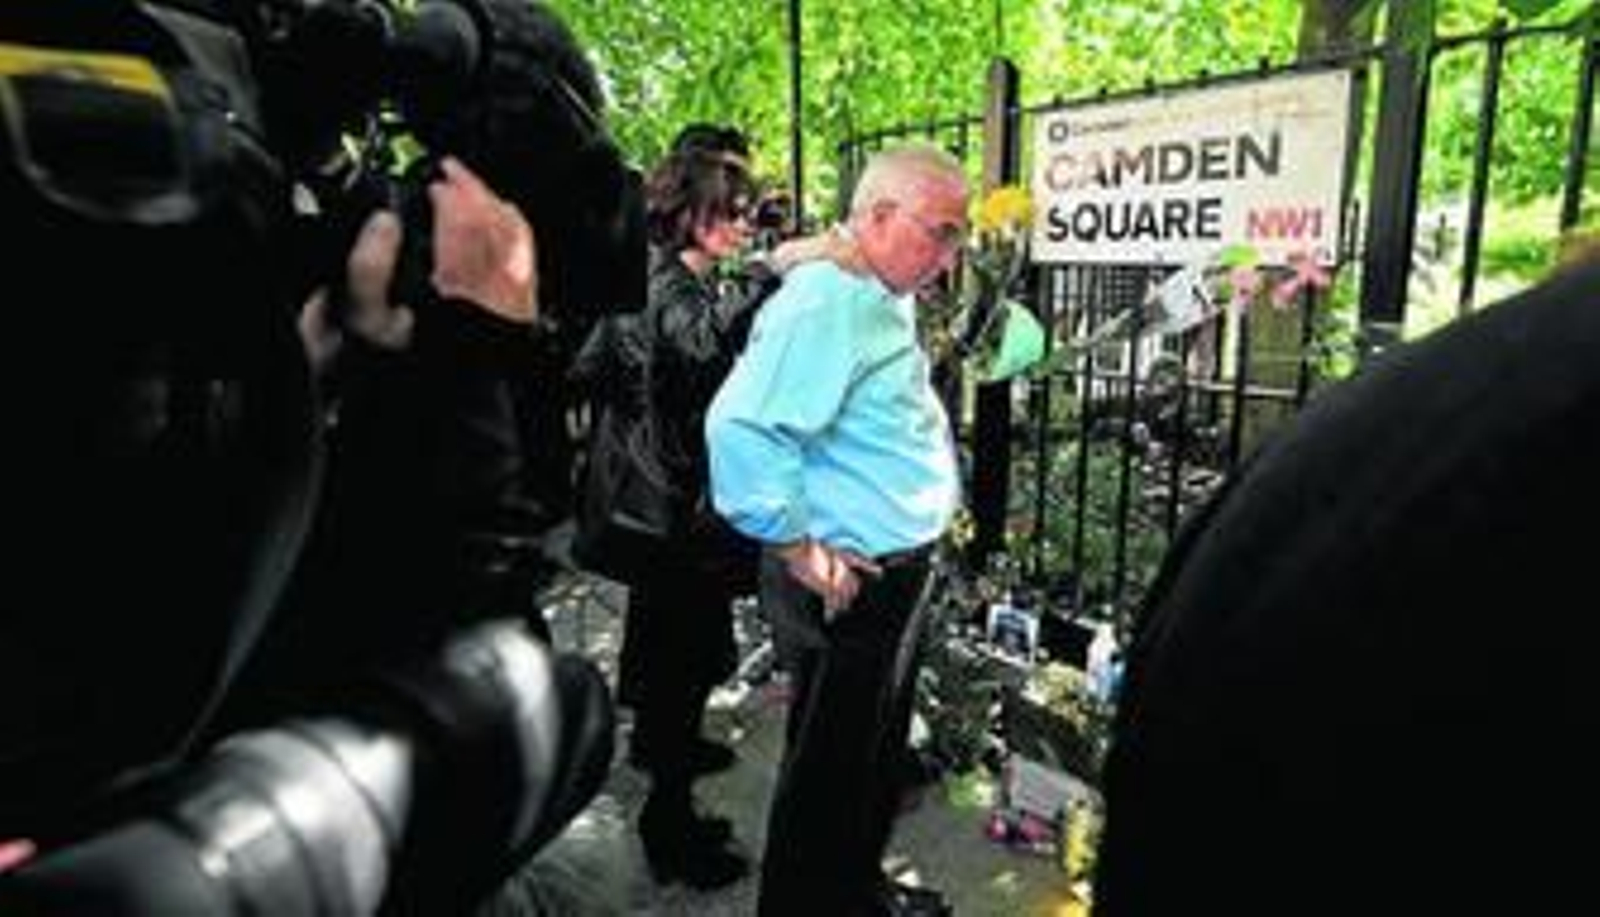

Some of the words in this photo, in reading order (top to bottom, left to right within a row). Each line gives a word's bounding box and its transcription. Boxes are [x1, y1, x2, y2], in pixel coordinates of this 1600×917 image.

[1046, 131, 1280, 191] CAMDEN
[1048, 199, 1222, 242] SQUARE
[1247, 207, 1322, 240] NW1
